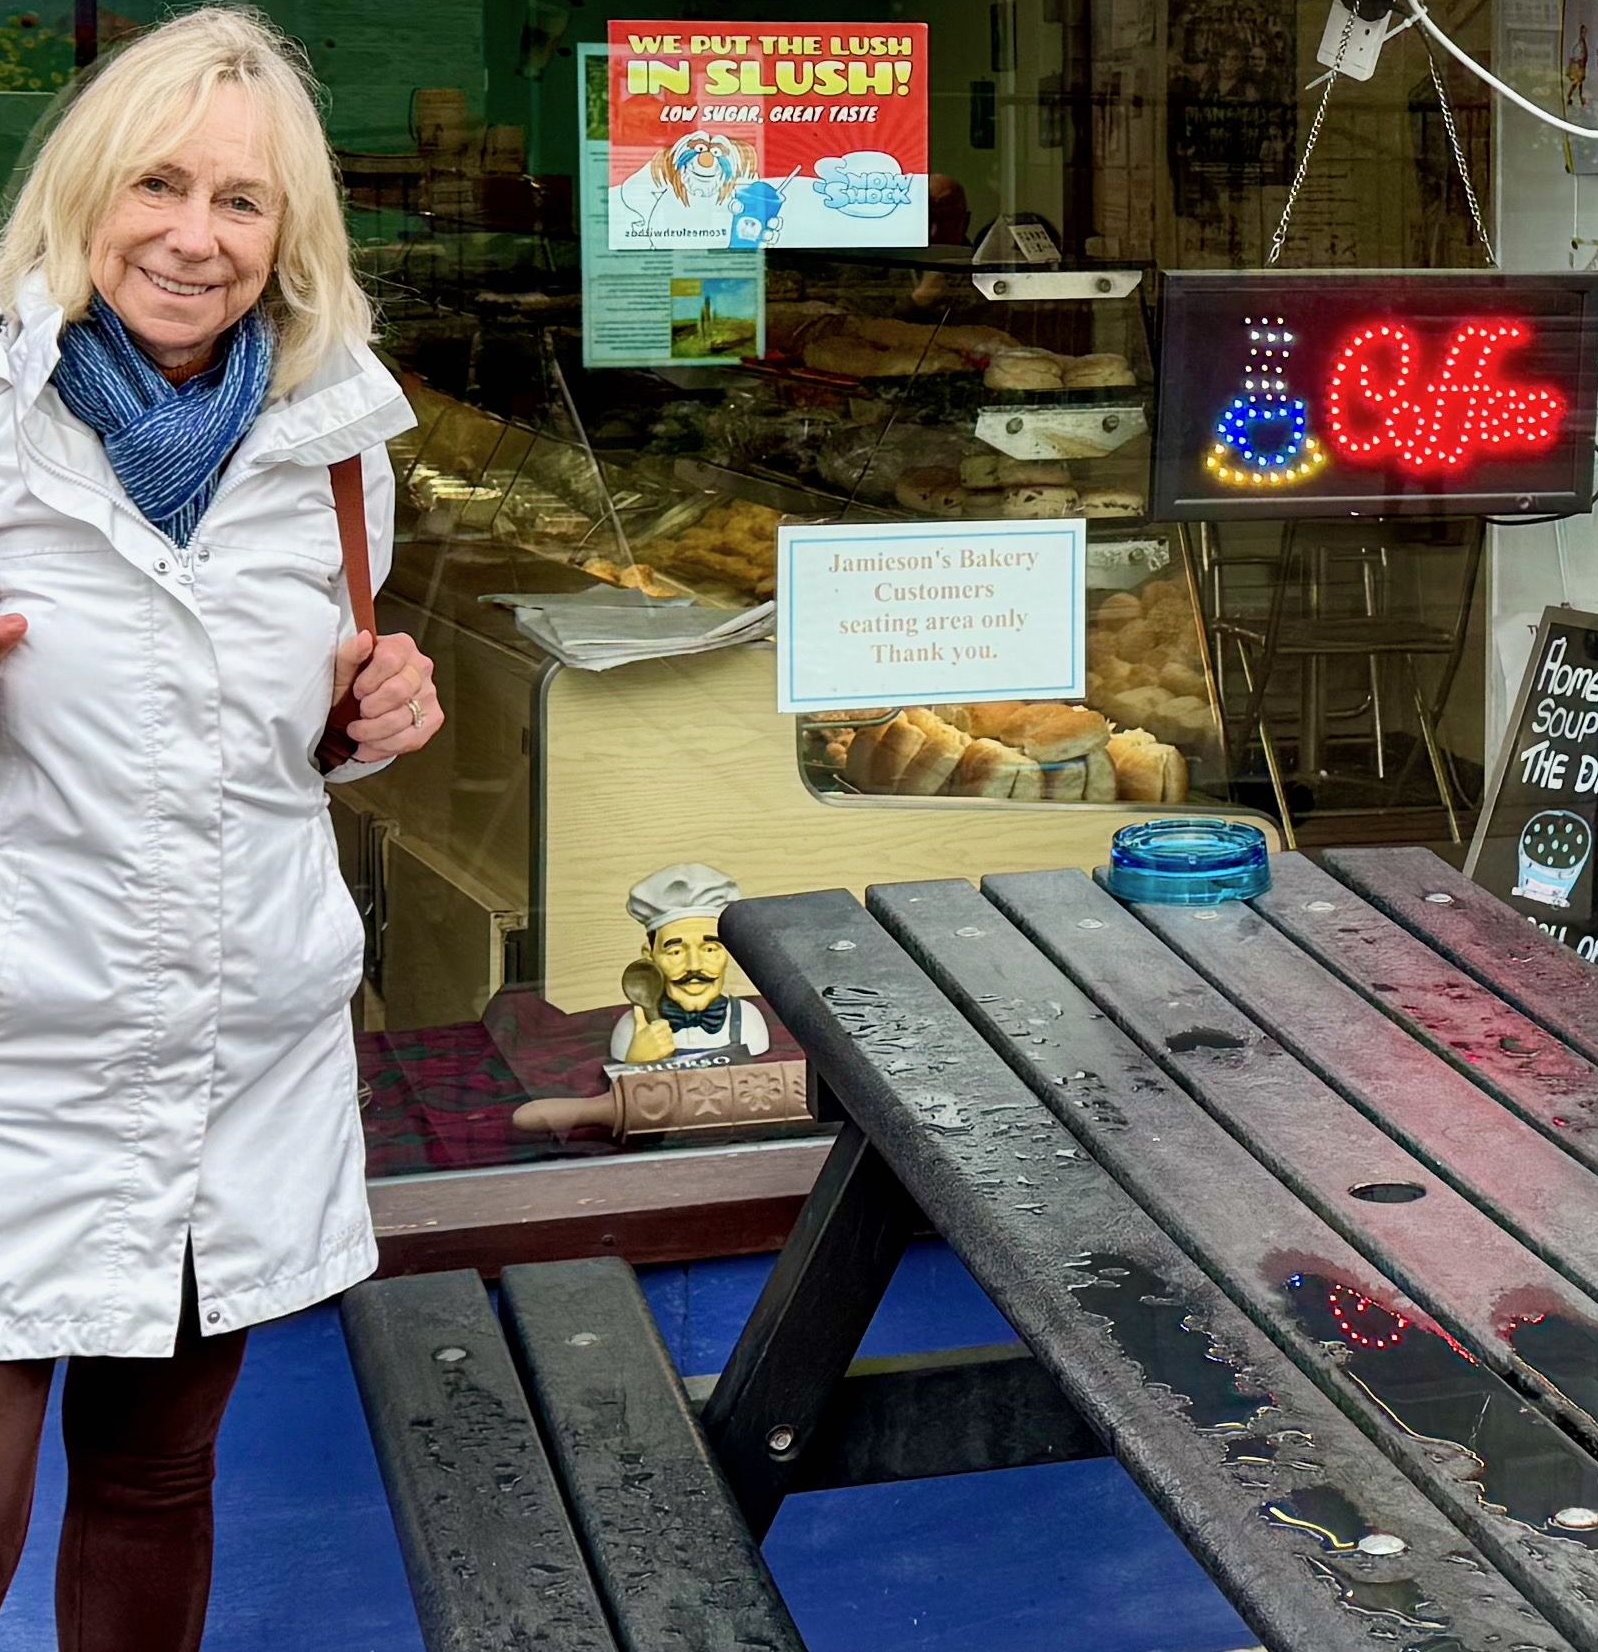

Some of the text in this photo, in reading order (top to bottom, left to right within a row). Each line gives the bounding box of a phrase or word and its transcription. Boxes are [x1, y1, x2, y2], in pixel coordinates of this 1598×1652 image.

[627, 34, 913, 57] WE PUT THE LUSH
[626, 59, 914, 97] IN SLUSH!
[659, 105, 880, 125] LOW SUGAR, GREAT TASTE
[828, 548, 1039, 574] Jamieson's Bakery
[874, 581, 995, 603] Customers
[838, 608, 1028, 637] seating area only
[871, 642, 998, 666] Thank you.
[1520, 739, 1570, 790] THE
